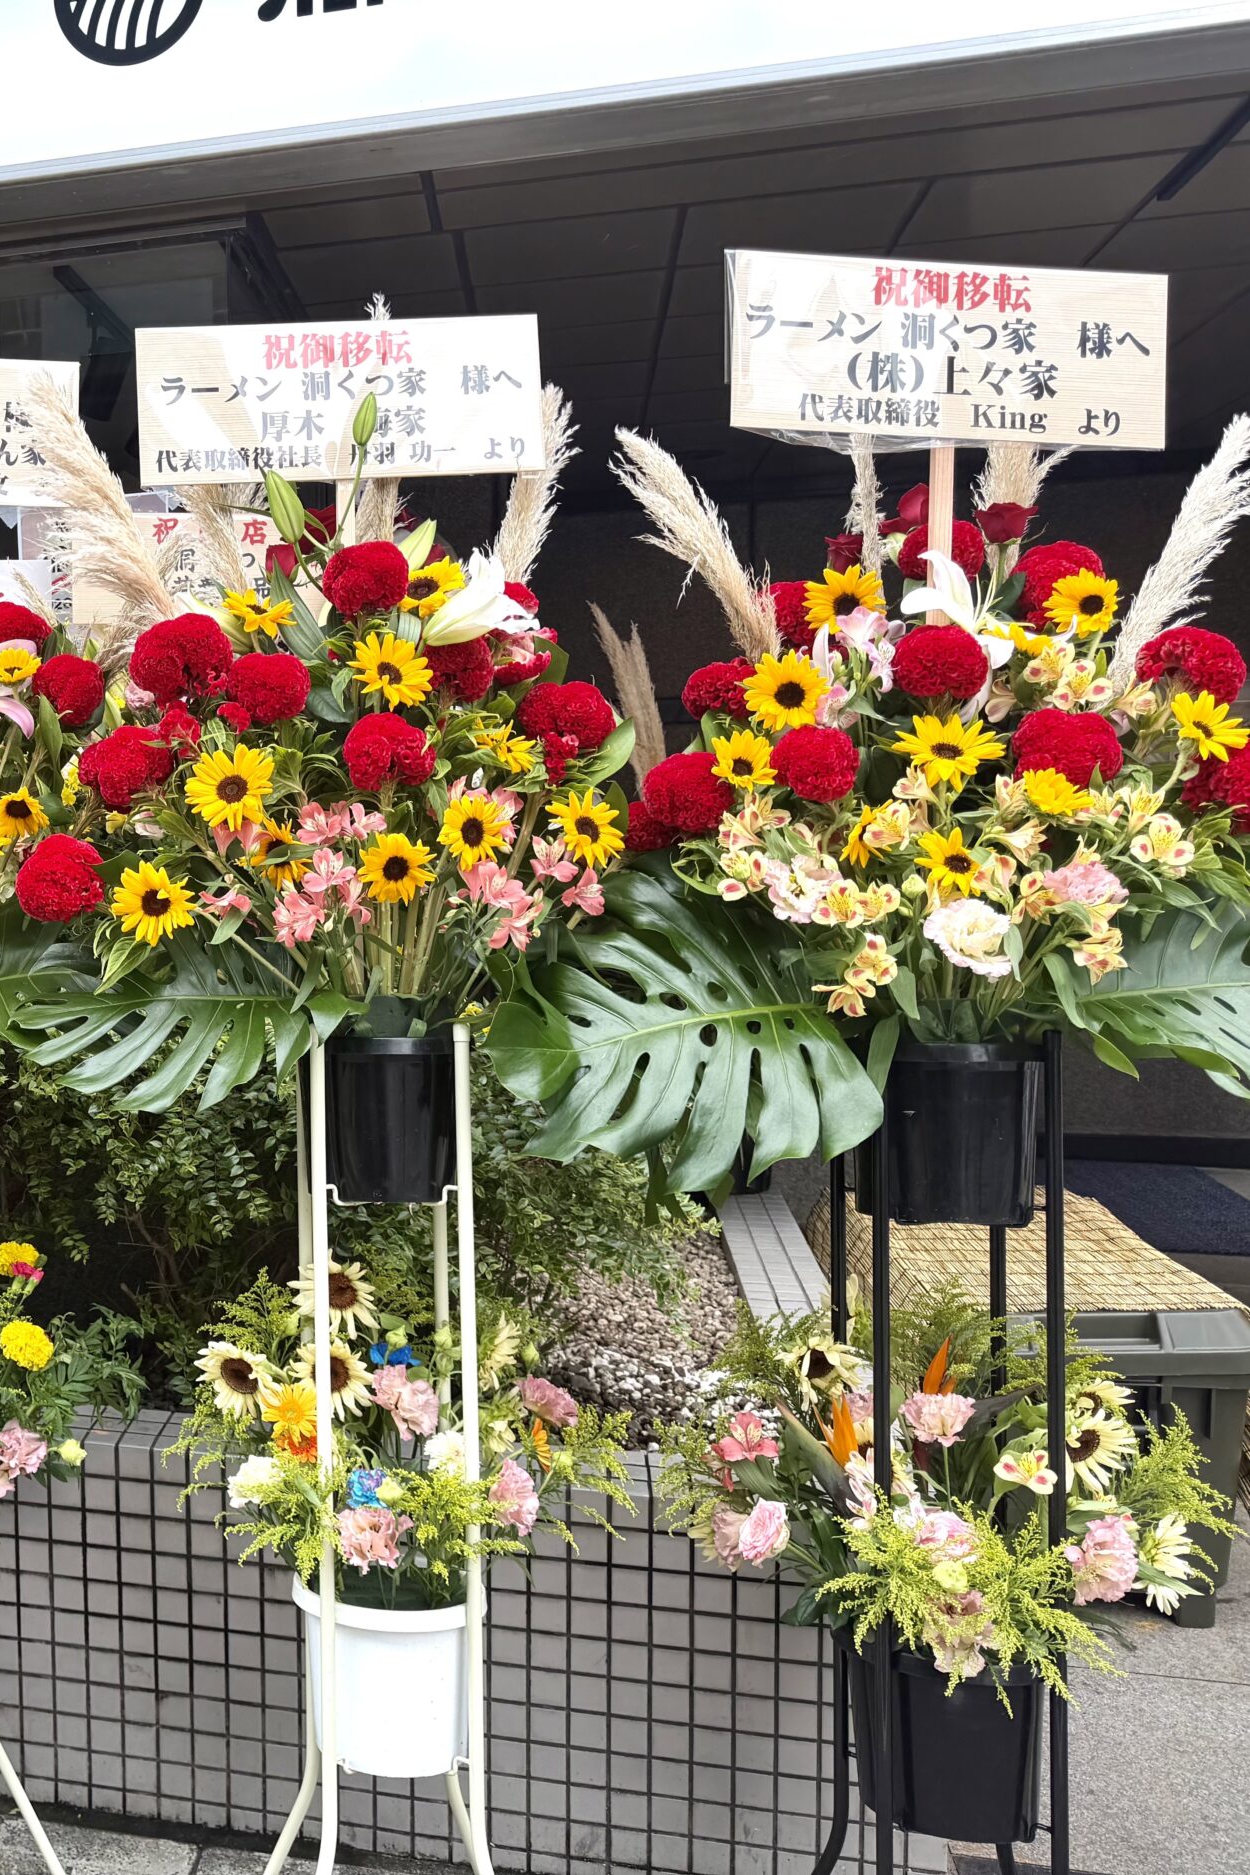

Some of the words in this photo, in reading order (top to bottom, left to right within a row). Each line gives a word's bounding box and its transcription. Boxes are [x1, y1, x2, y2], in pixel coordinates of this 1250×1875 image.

[871, 266, 1032, 313] 祝御移転
[262, 330, 412, 370] 祝御移転
[746, 304, 882, 345] ラーメン
[900, 312, 1037, 355] 洞くつ家
[1077, 321, 1151, 359] 様へ
[160, 375, 282, 406] ラーメン
[302, 367, 427, 401] 洞くつ家
[460, 364, 523, 395] 様へ
[261, 410, 325, 443] 厚木
[798, 393, 941, 428] 代表取締役
[970, 403, 1049, 435] King
[1077, 409, 1121, 436] より
[155, 444, 323, 473] 代表取締役社長
[409, 440, 457, 463] 功一
[483, 436, 525, 460] より
